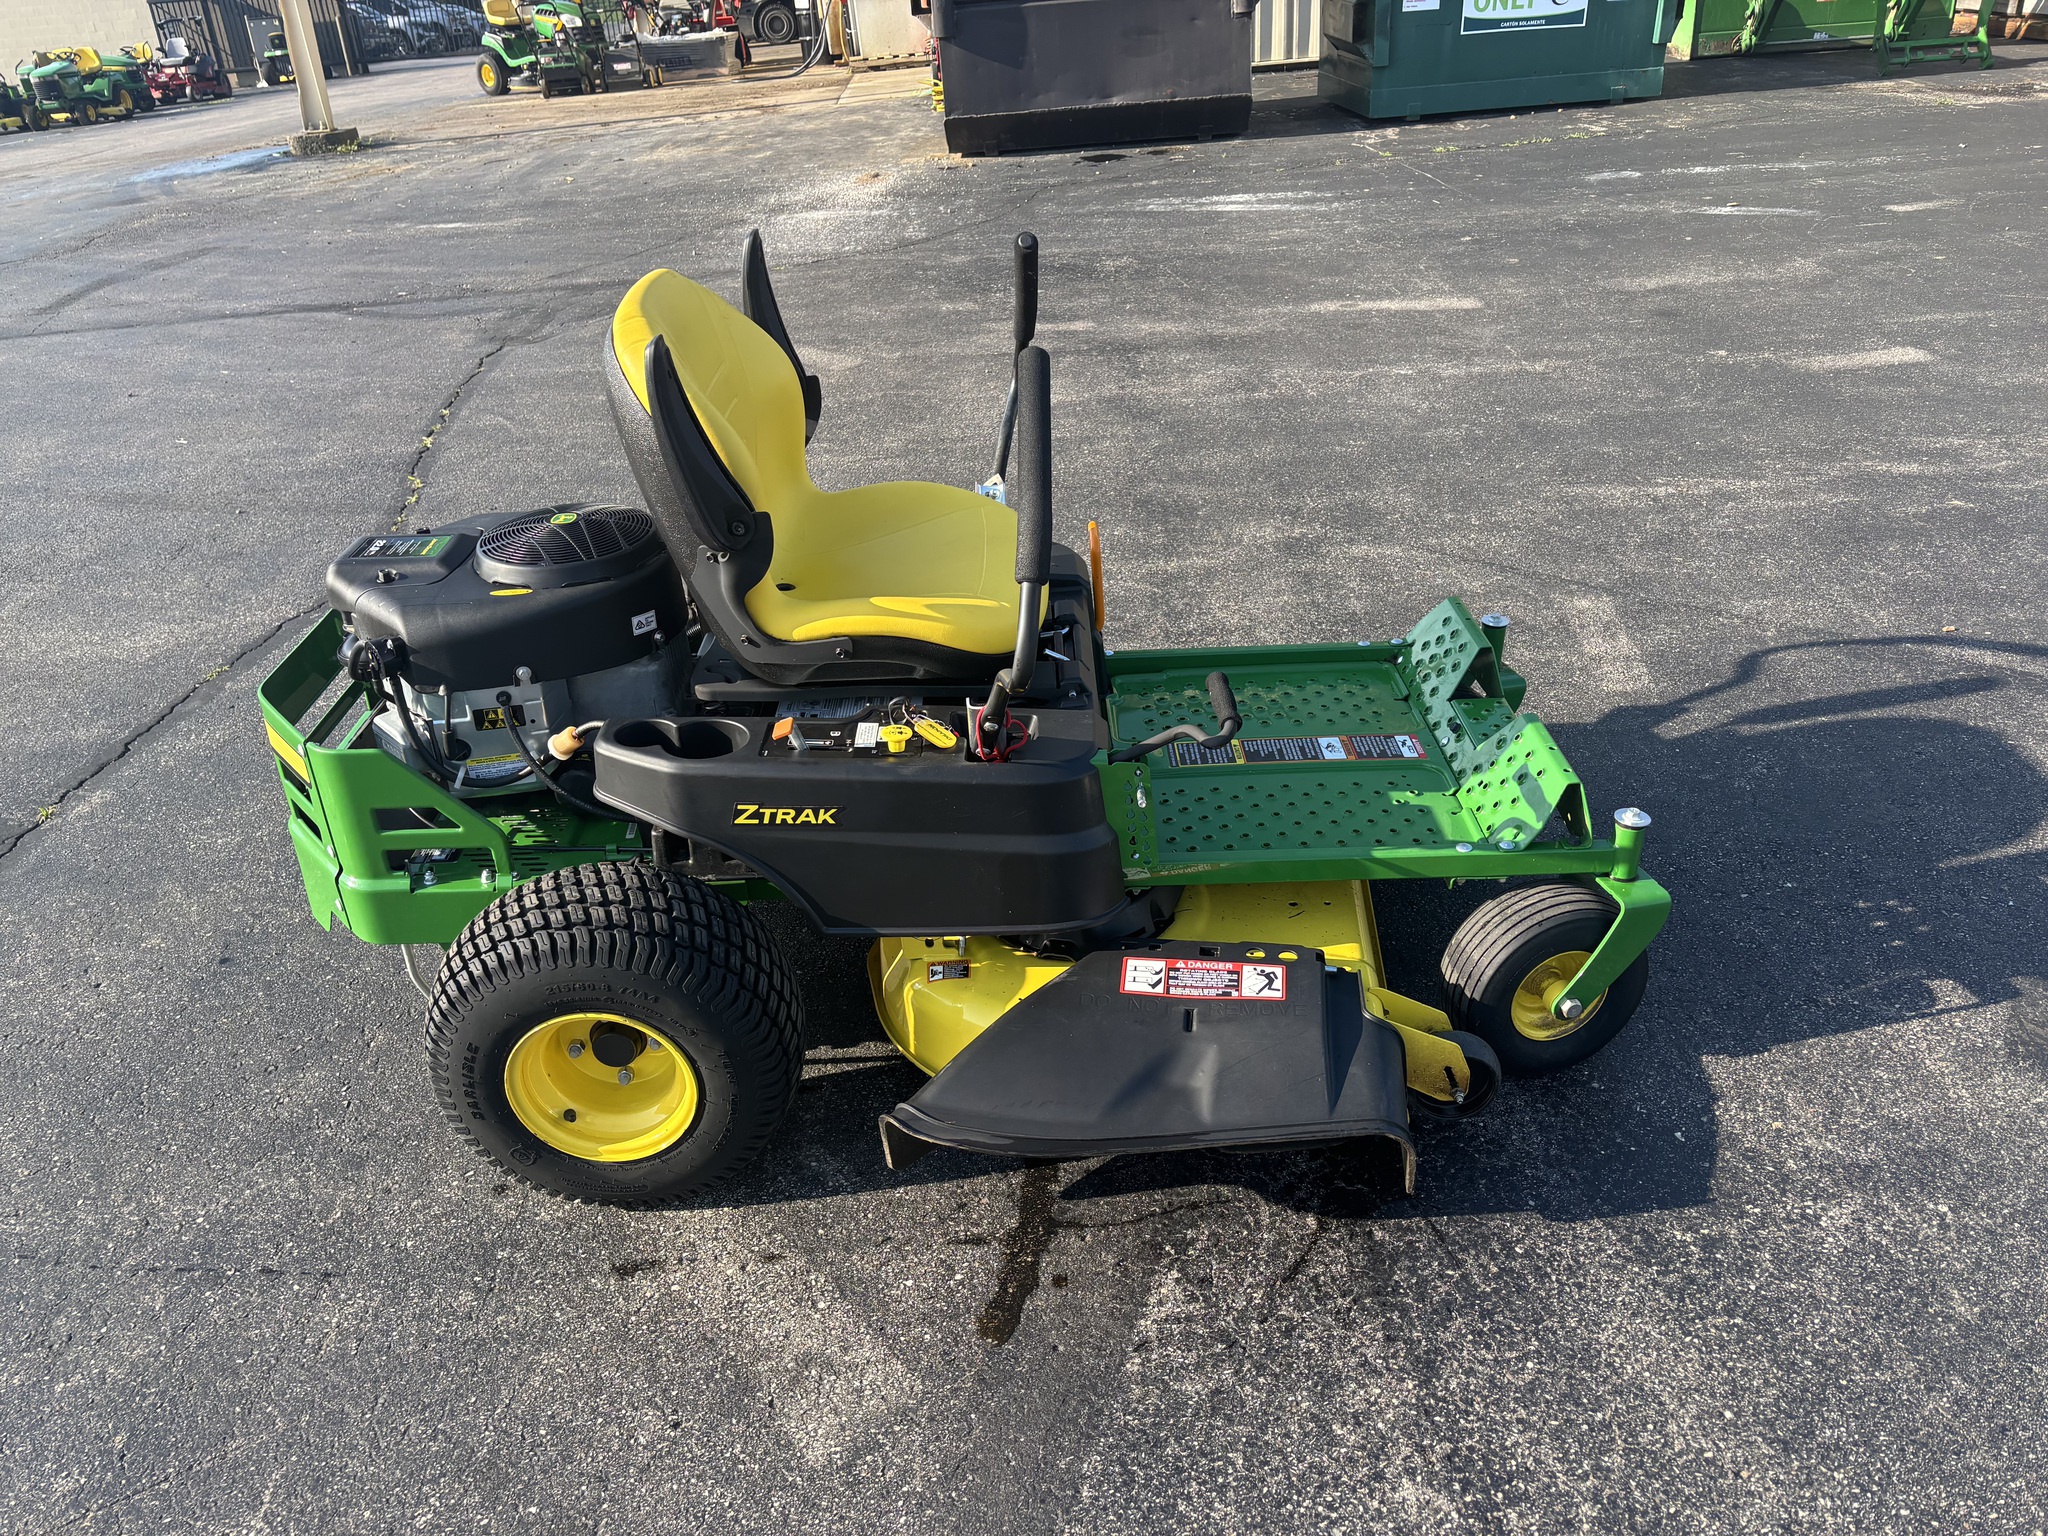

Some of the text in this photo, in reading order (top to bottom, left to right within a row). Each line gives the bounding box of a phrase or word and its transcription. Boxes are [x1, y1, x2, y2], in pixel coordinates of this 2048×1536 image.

[734, 804, 838, 824] ZTRAK
[1187, 961, 1234, 970] DANGER
[1079, 993, 1308, 1017] DO NOT REMOVE
[461, 1041, 487, 1120] CARLISLE
